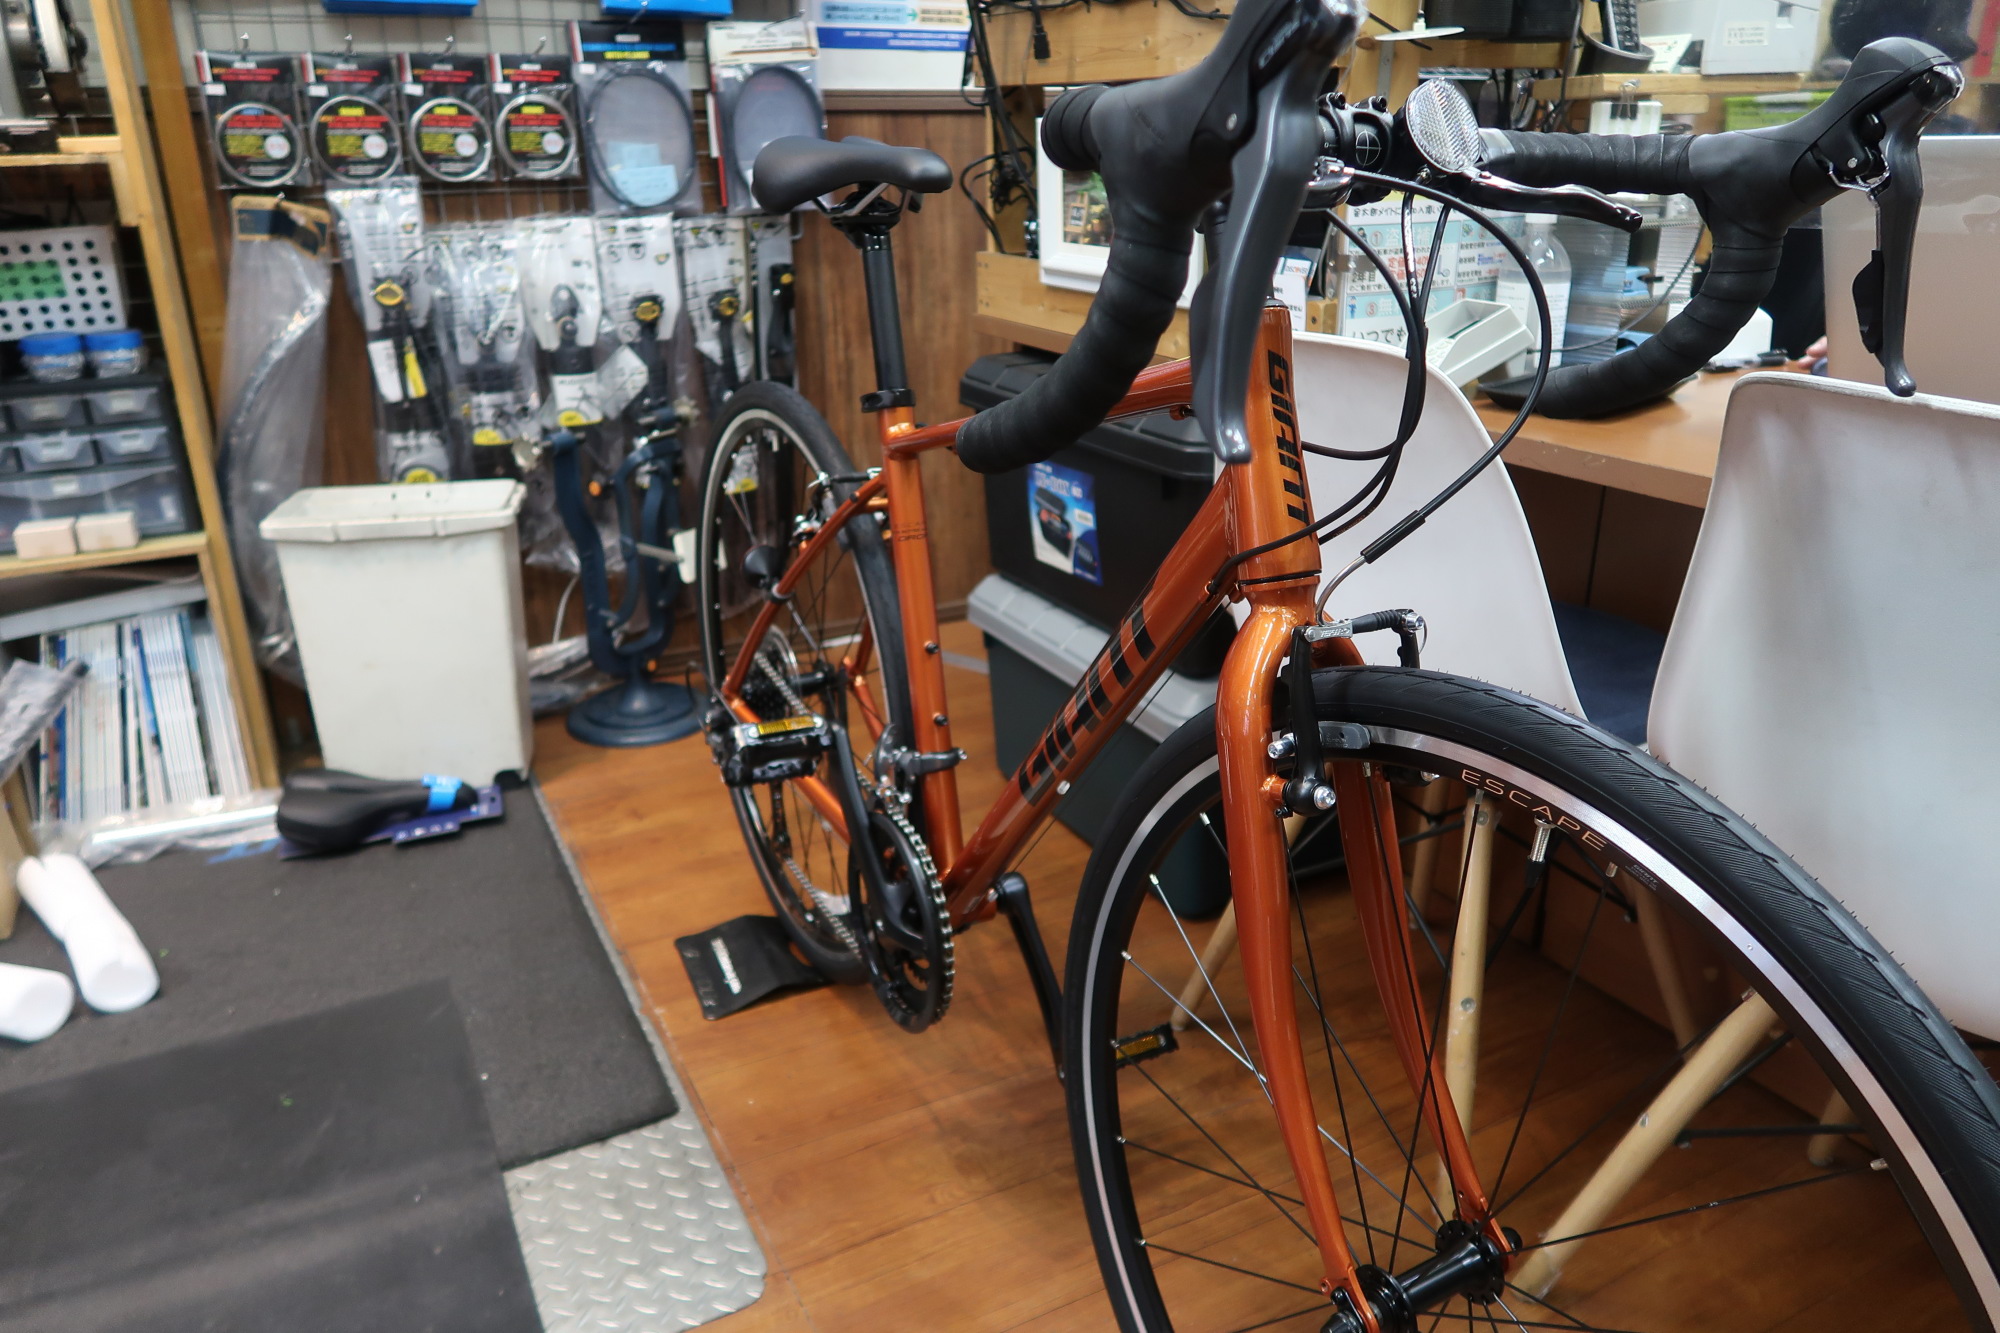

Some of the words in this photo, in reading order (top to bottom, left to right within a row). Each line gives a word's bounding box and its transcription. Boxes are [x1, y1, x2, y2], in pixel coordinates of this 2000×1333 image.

[1267, 349, 1314, 543] GIANT
[1019, 596, 1157, 808] GIANT
[1461, 769, 1608, 851] ESCAPE
